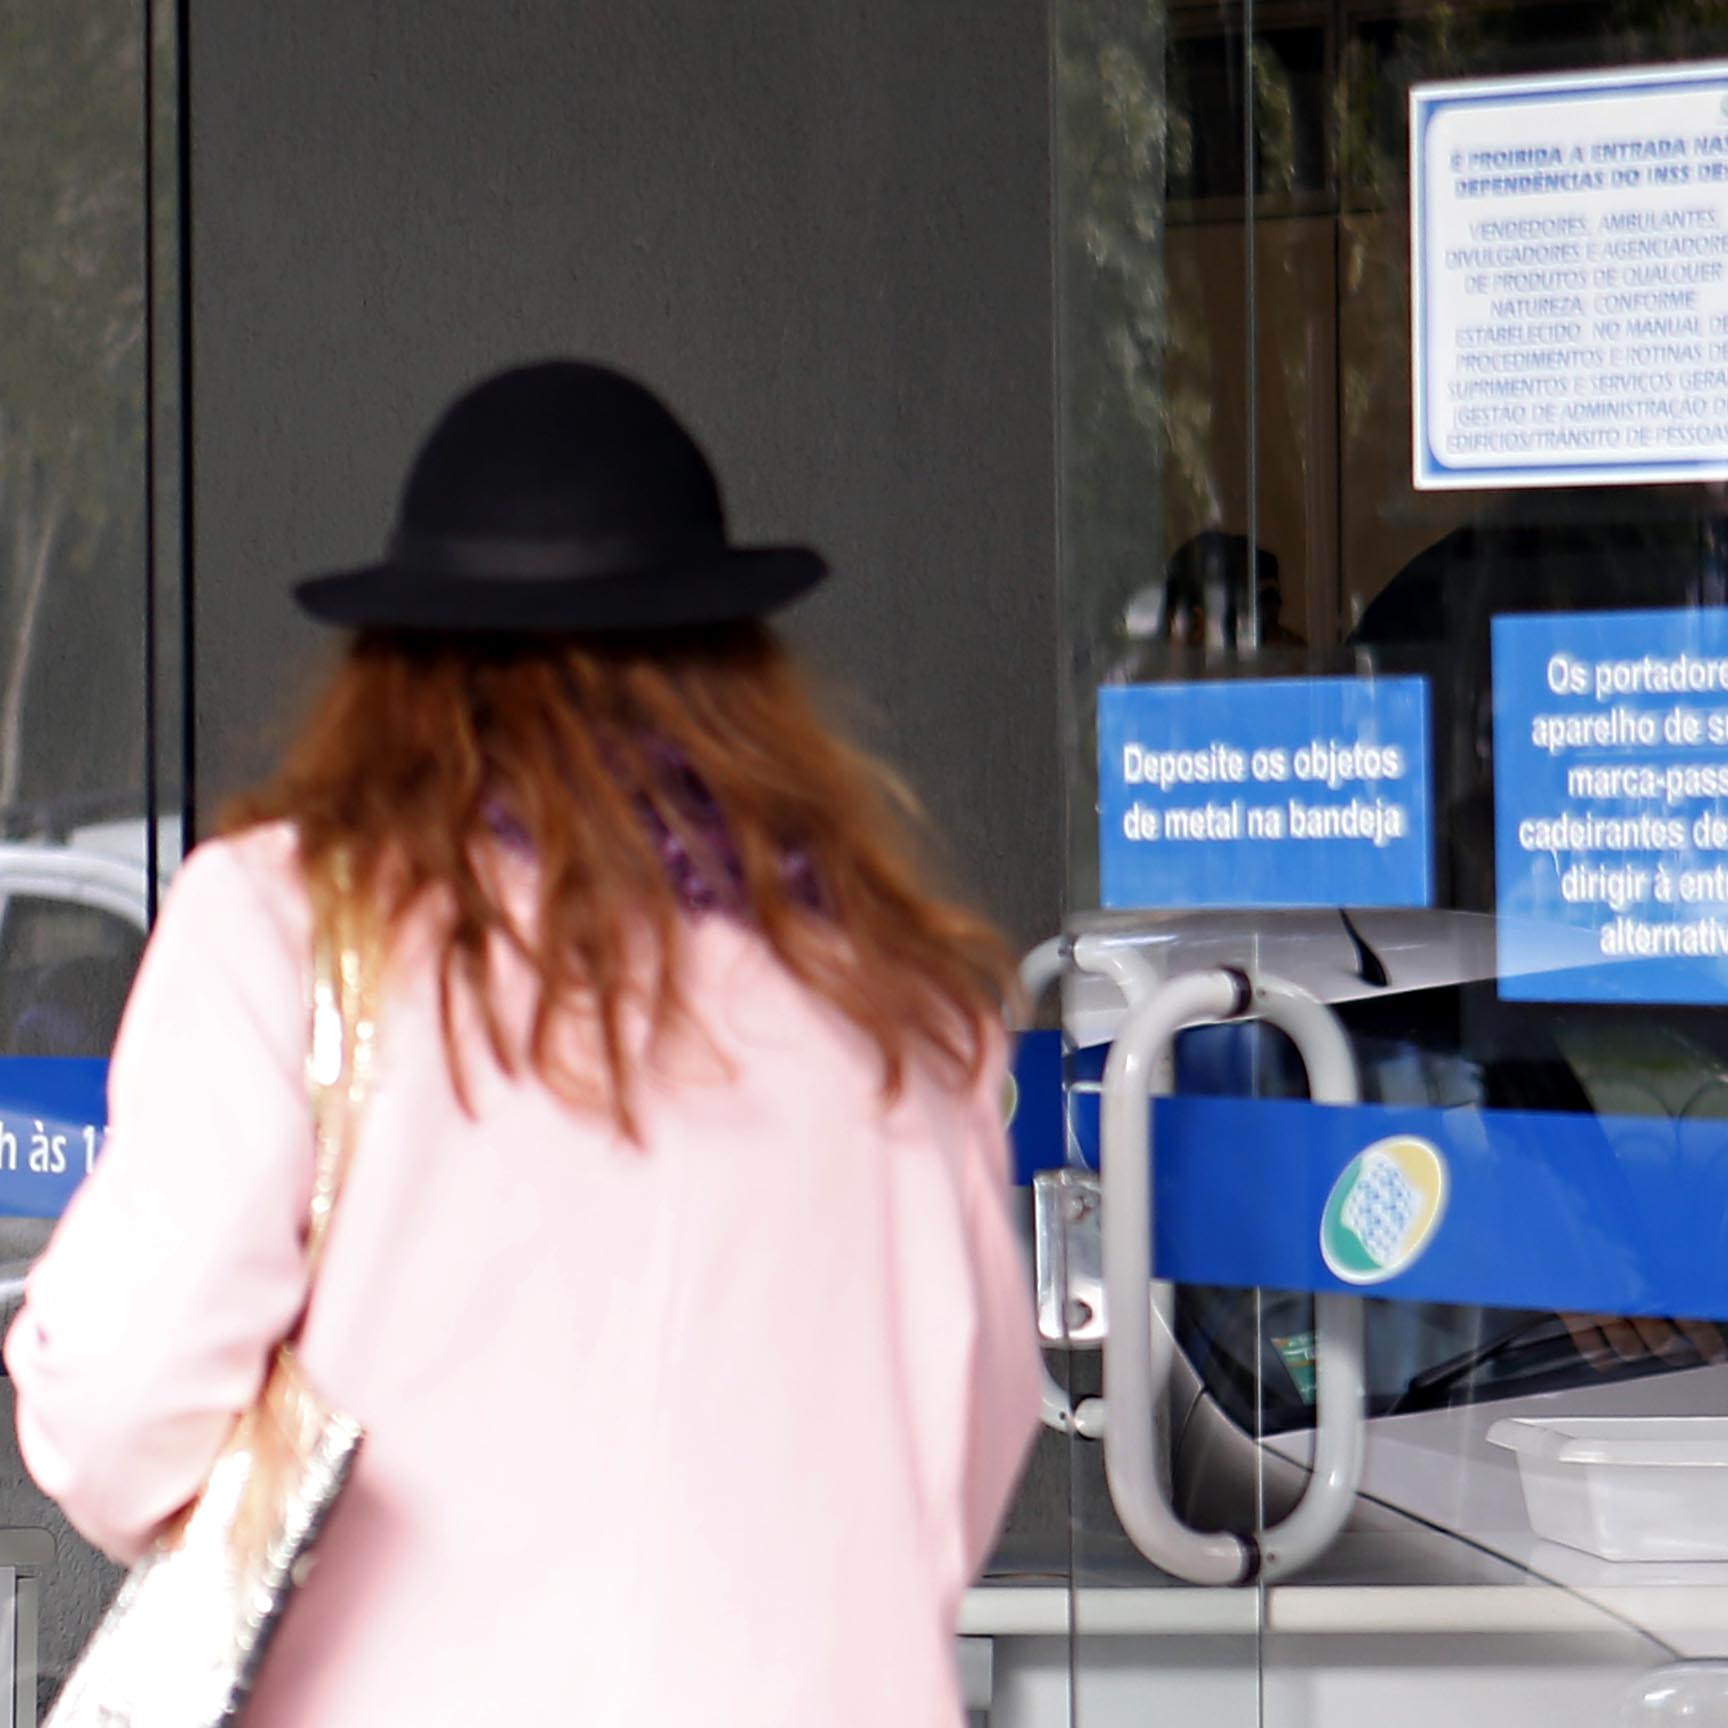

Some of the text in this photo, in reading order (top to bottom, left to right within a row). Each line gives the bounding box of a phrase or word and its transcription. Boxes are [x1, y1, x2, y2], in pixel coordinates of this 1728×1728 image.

[1547, 658, 1587, 695] Os
[1531, 709, 1657, 751] aparelho
[1664, 707, 1700, 744] de
[1122, 739, 1400, 788] Deposite os objetos
[1123, 799, 1402, 849] de metal na bandeja
[1518, 812, 1688, 852] cadeirantes
[1560, 865, 1649, 908] dirigir
[1654, 870, 1672, 901] à
[29, 1119, 67, 1174] às
